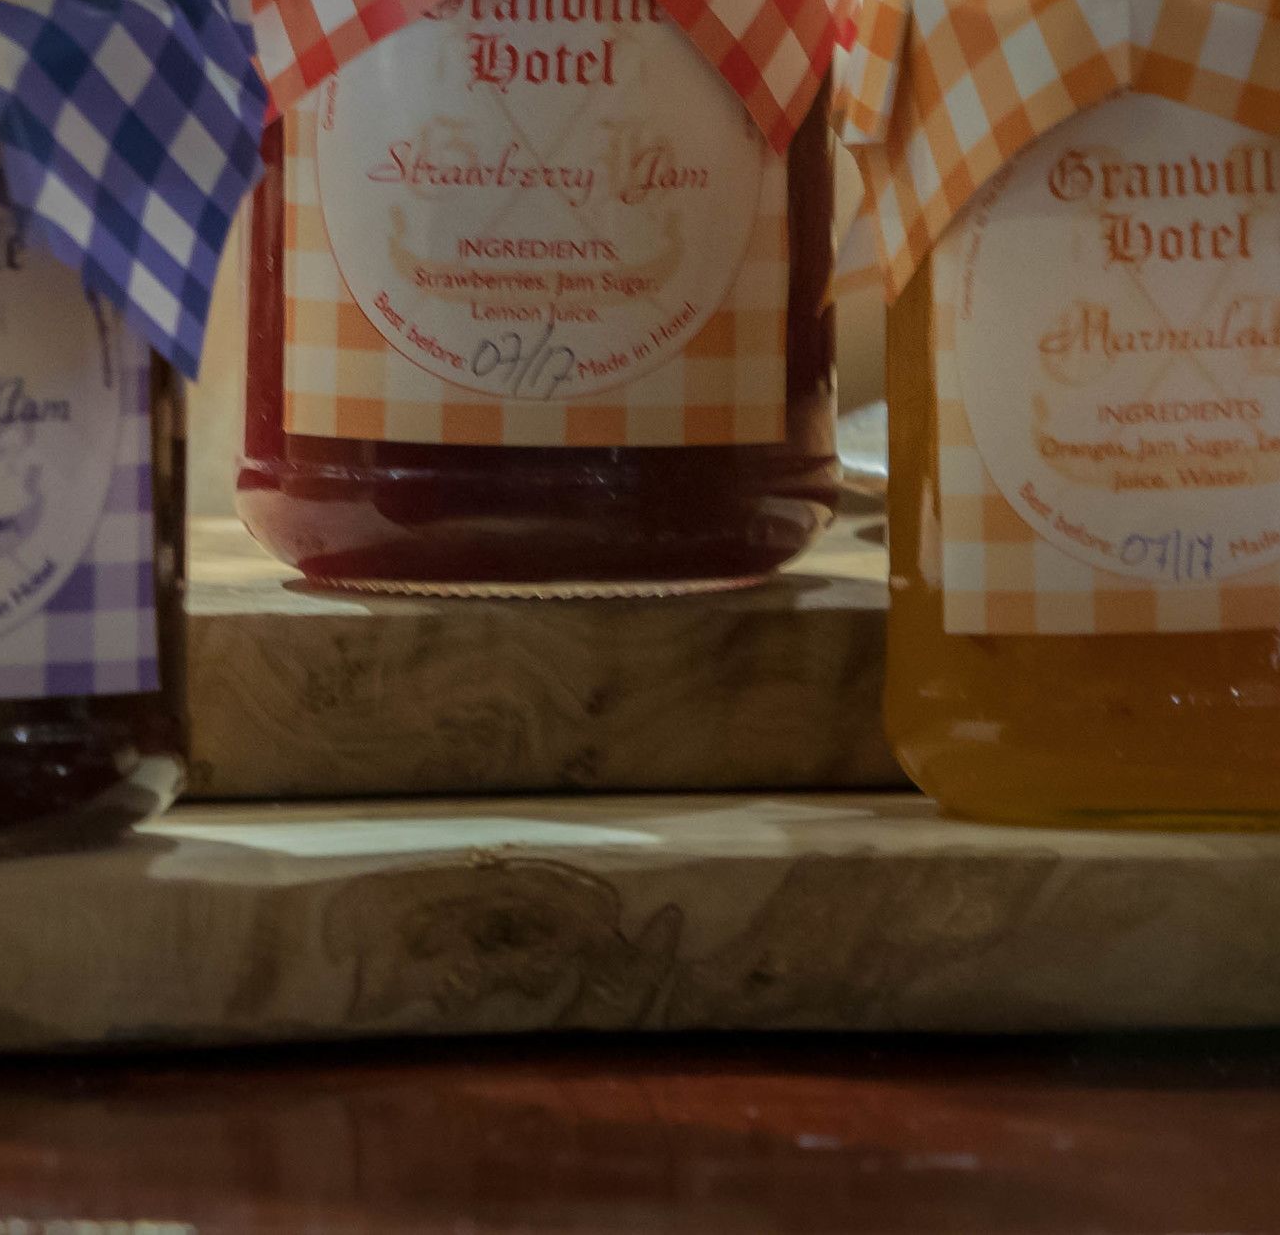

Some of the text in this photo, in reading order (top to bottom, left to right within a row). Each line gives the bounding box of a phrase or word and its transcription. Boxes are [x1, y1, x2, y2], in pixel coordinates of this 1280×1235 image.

[466, 31, 617, 94] Hotel
[367, 141, 711, 208] Strawberry Jam
[457, 238, 620, 260] INGREDIENTS
[1100, 212, 1254, 270] Hotel
[554, 270, 596, 296] Jam
[373, 289, 406, 333] Best
[470, 301, 542, 322] Lemon
[575, 299, 698, 380] Made in Hotel
[1096, 398, 1265, 426] INGREDIENTS
